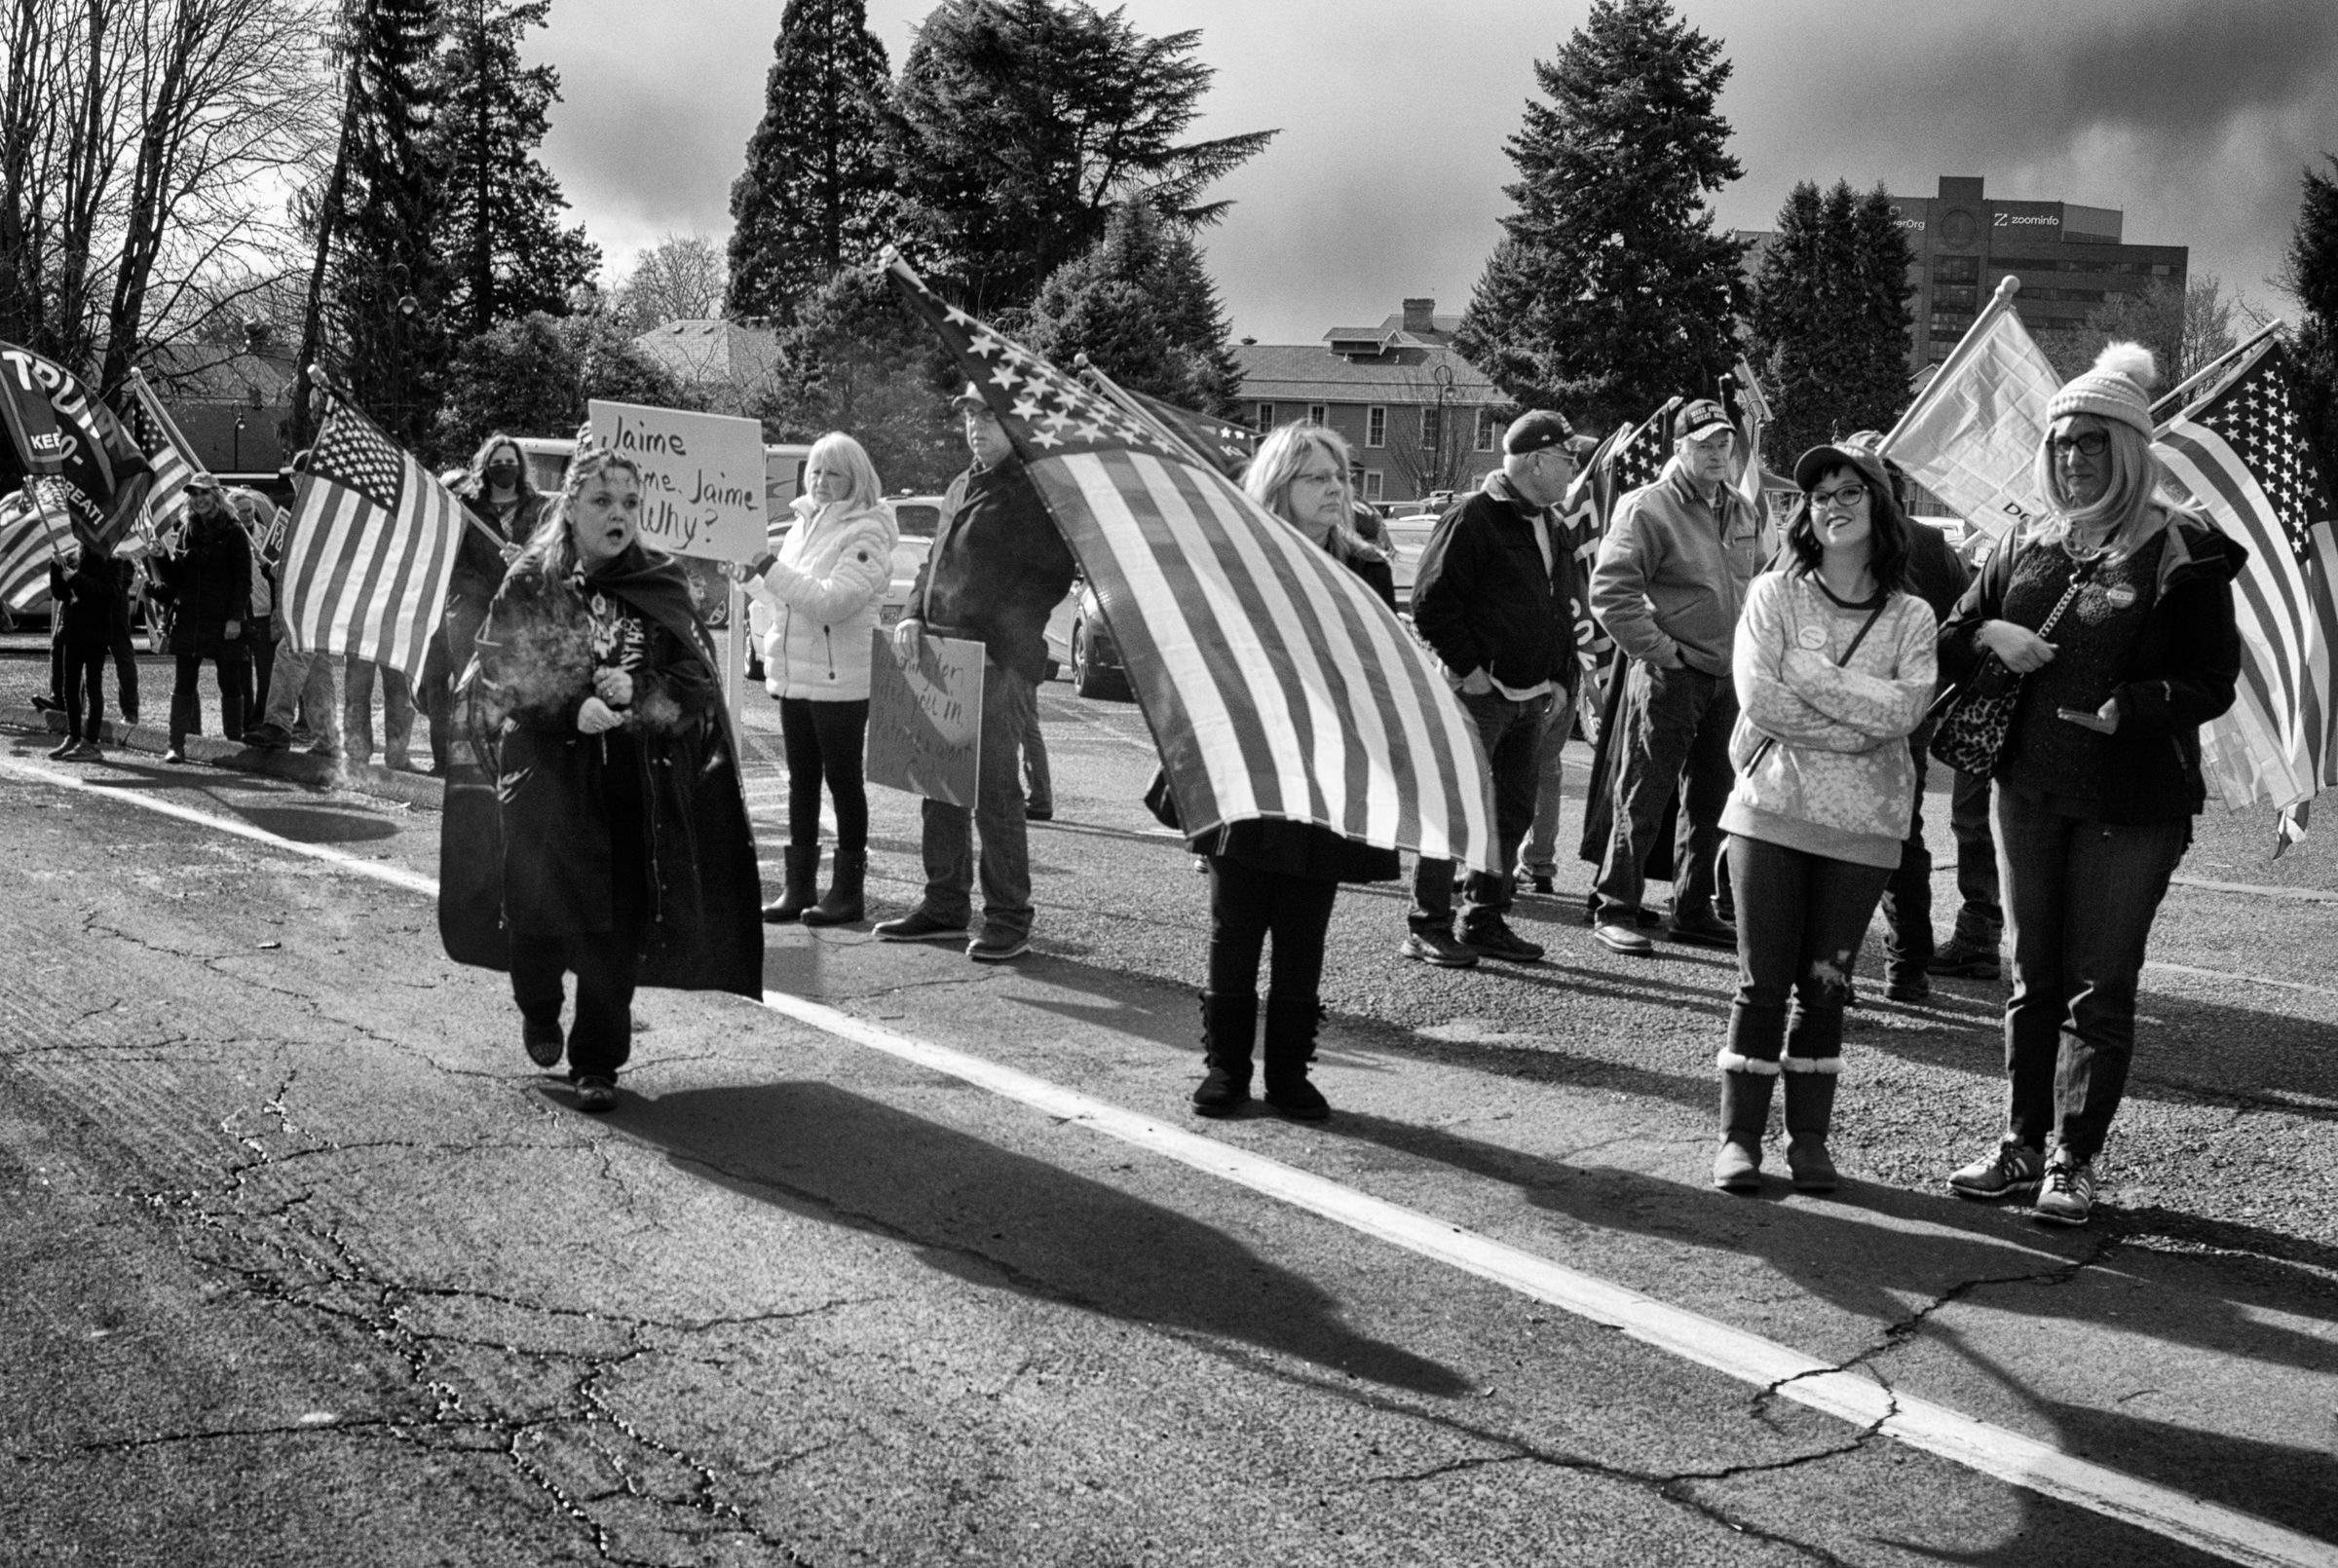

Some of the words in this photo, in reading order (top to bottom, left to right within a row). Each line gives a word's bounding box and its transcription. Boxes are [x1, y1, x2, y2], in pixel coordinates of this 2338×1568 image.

[2012, 215, 2059, 226] zoominfo
[30, 432, 59, 450] KEE
[602, 415, 686, 456] Jaime
[64, 481, 104, 525] REAT!
[688, 468, 759, 511] Jaime
[640, 498, 719, 550] Why?
